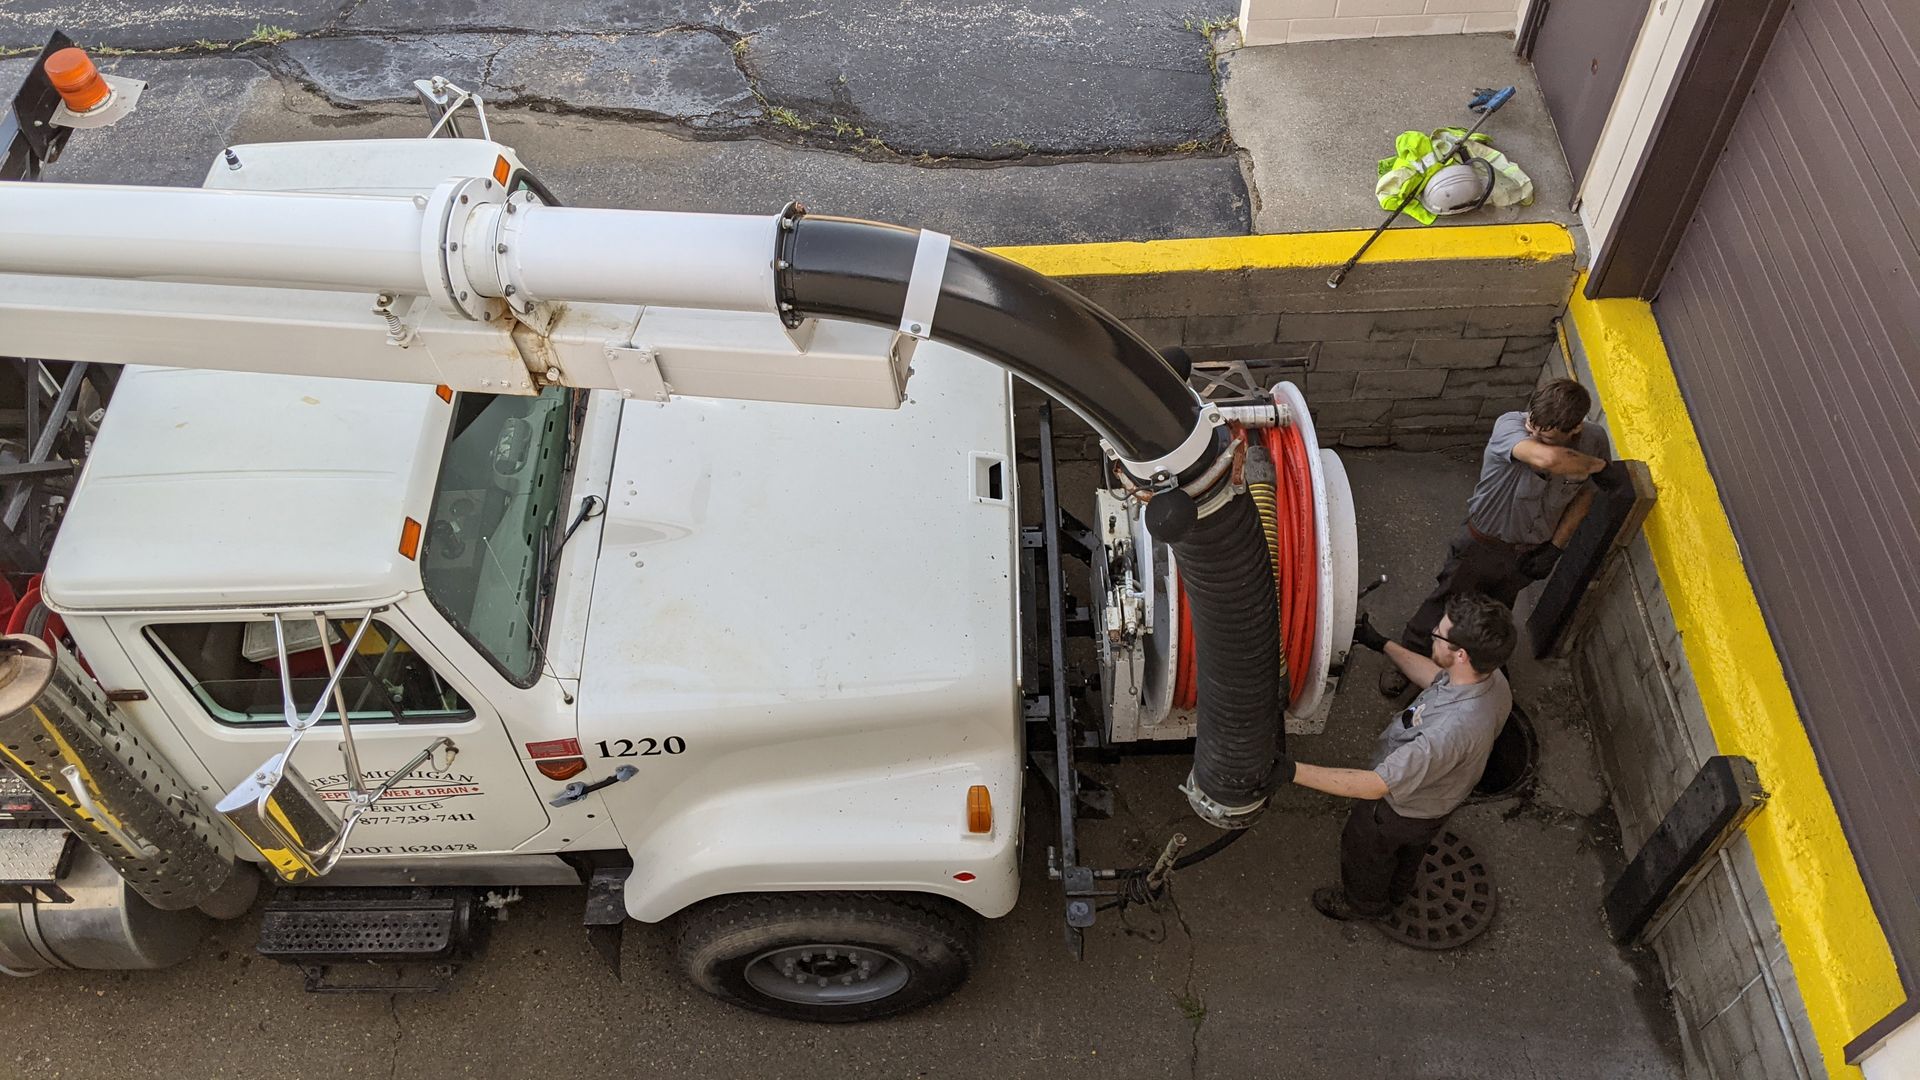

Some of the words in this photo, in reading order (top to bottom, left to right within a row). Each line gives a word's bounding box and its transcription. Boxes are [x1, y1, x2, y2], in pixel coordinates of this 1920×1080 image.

[595, 736, 686, 758] 1220
[427, 786, 469, 795] DRAIN
[364, 802, 444, 812] ERVICE
[344, 813, 476, 825] 1877-739-7411
[399, 843, 478, 853] 1620478
